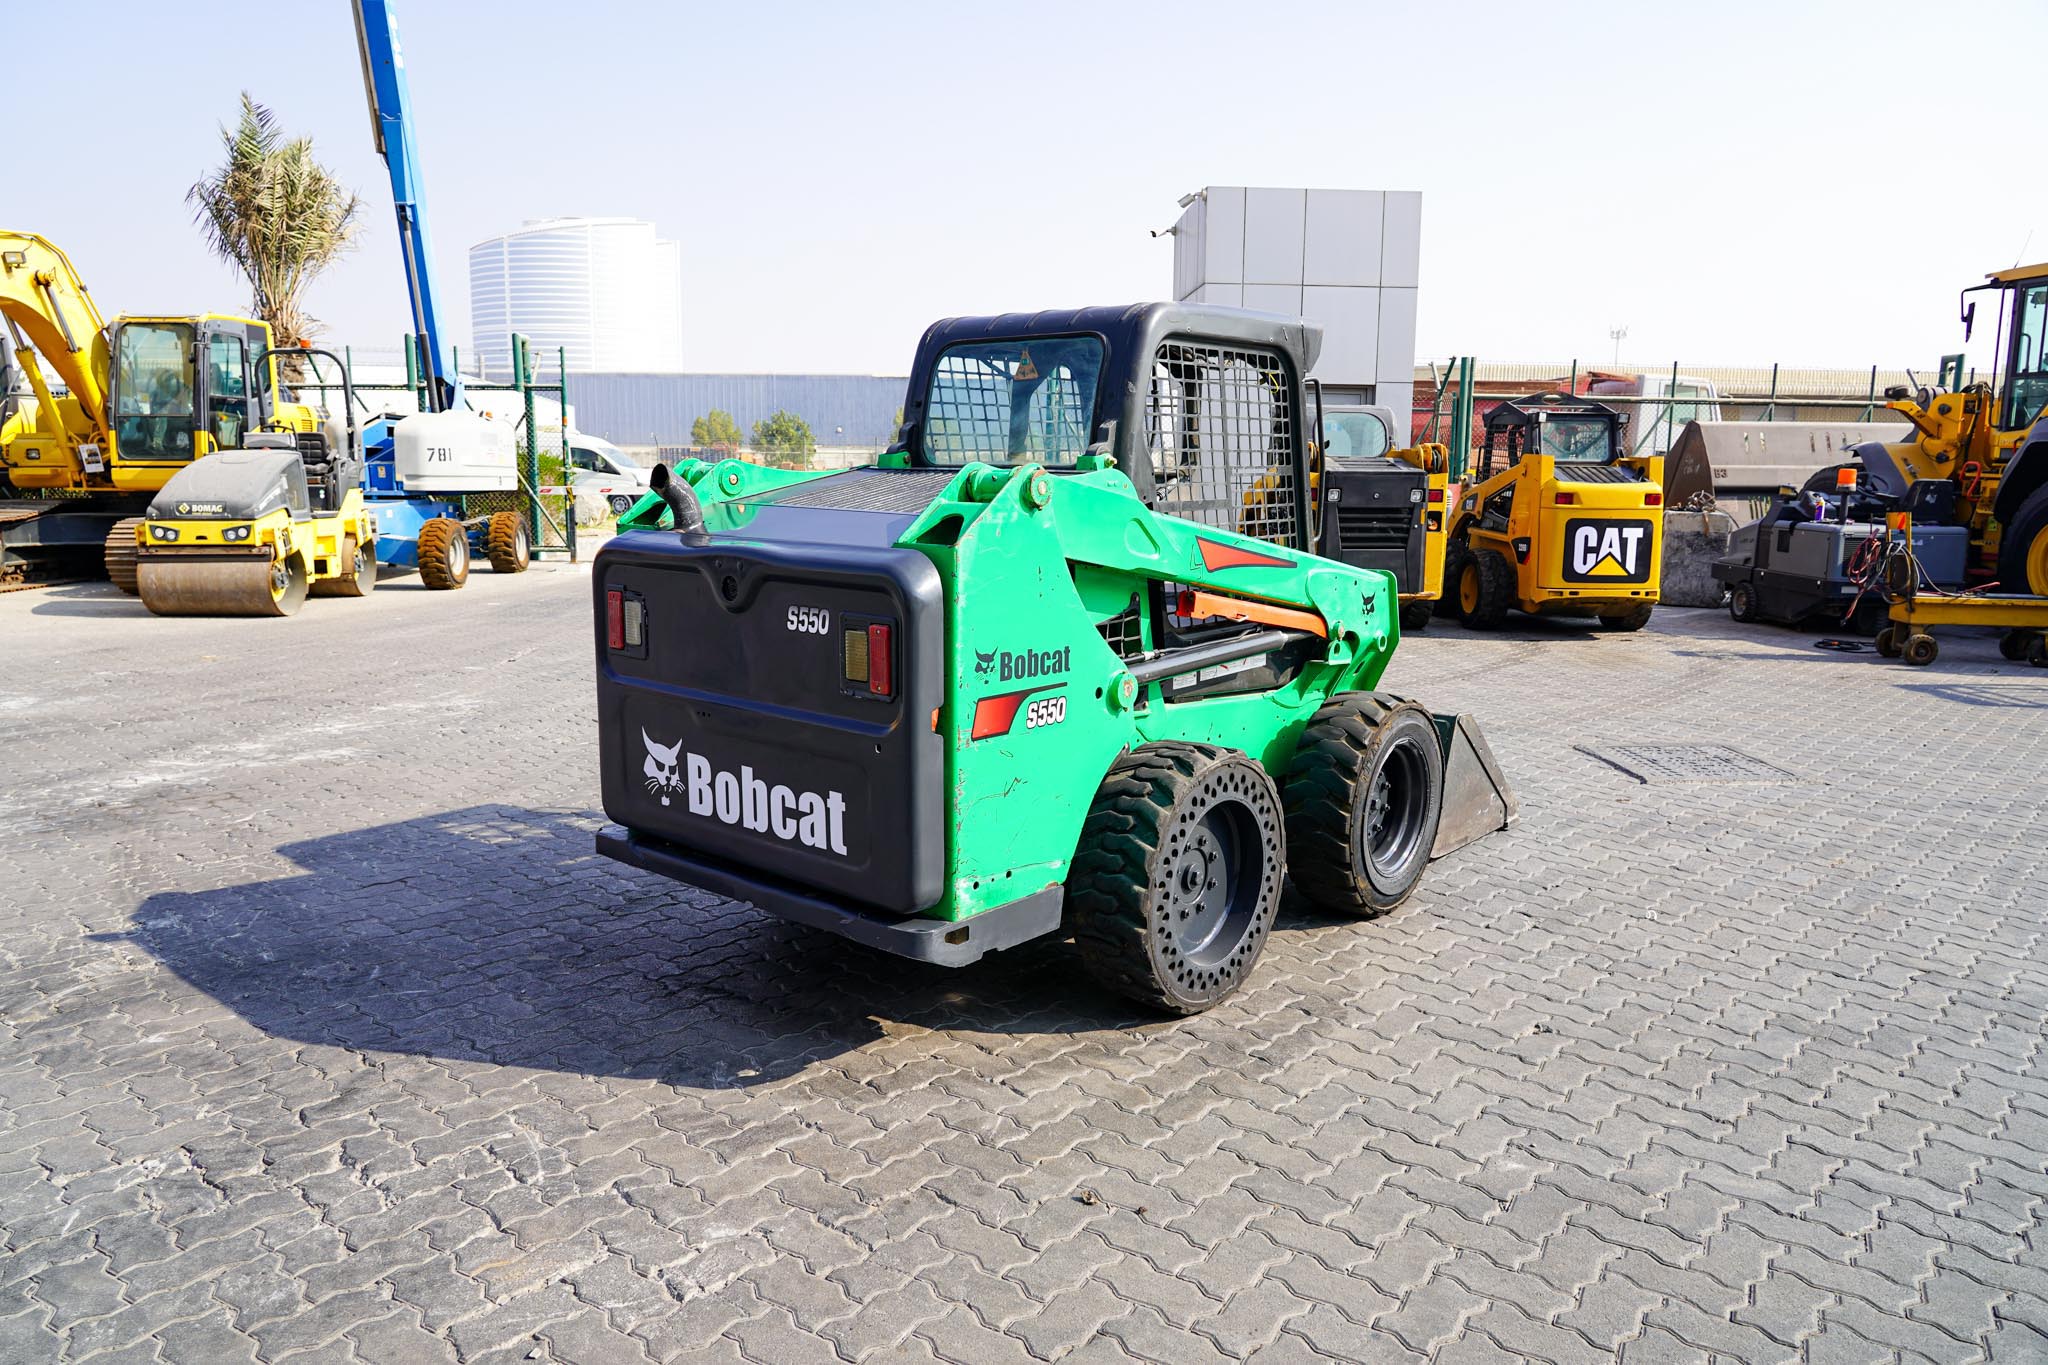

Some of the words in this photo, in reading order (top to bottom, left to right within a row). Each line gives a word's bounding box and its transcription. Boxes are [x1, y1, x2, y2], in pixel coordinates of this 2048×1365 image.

[427, 448, 452, 462] 781
[191, 504, 223, 513] BOMAG
[1573, 525, 1644, 575] CAT
[787, 605, 830, 635] S550
[999, 645, 1071, 682] Bobcat
[1026, 696, 1067, 729] S550
[687, 752, 848, 856] Bobcat
